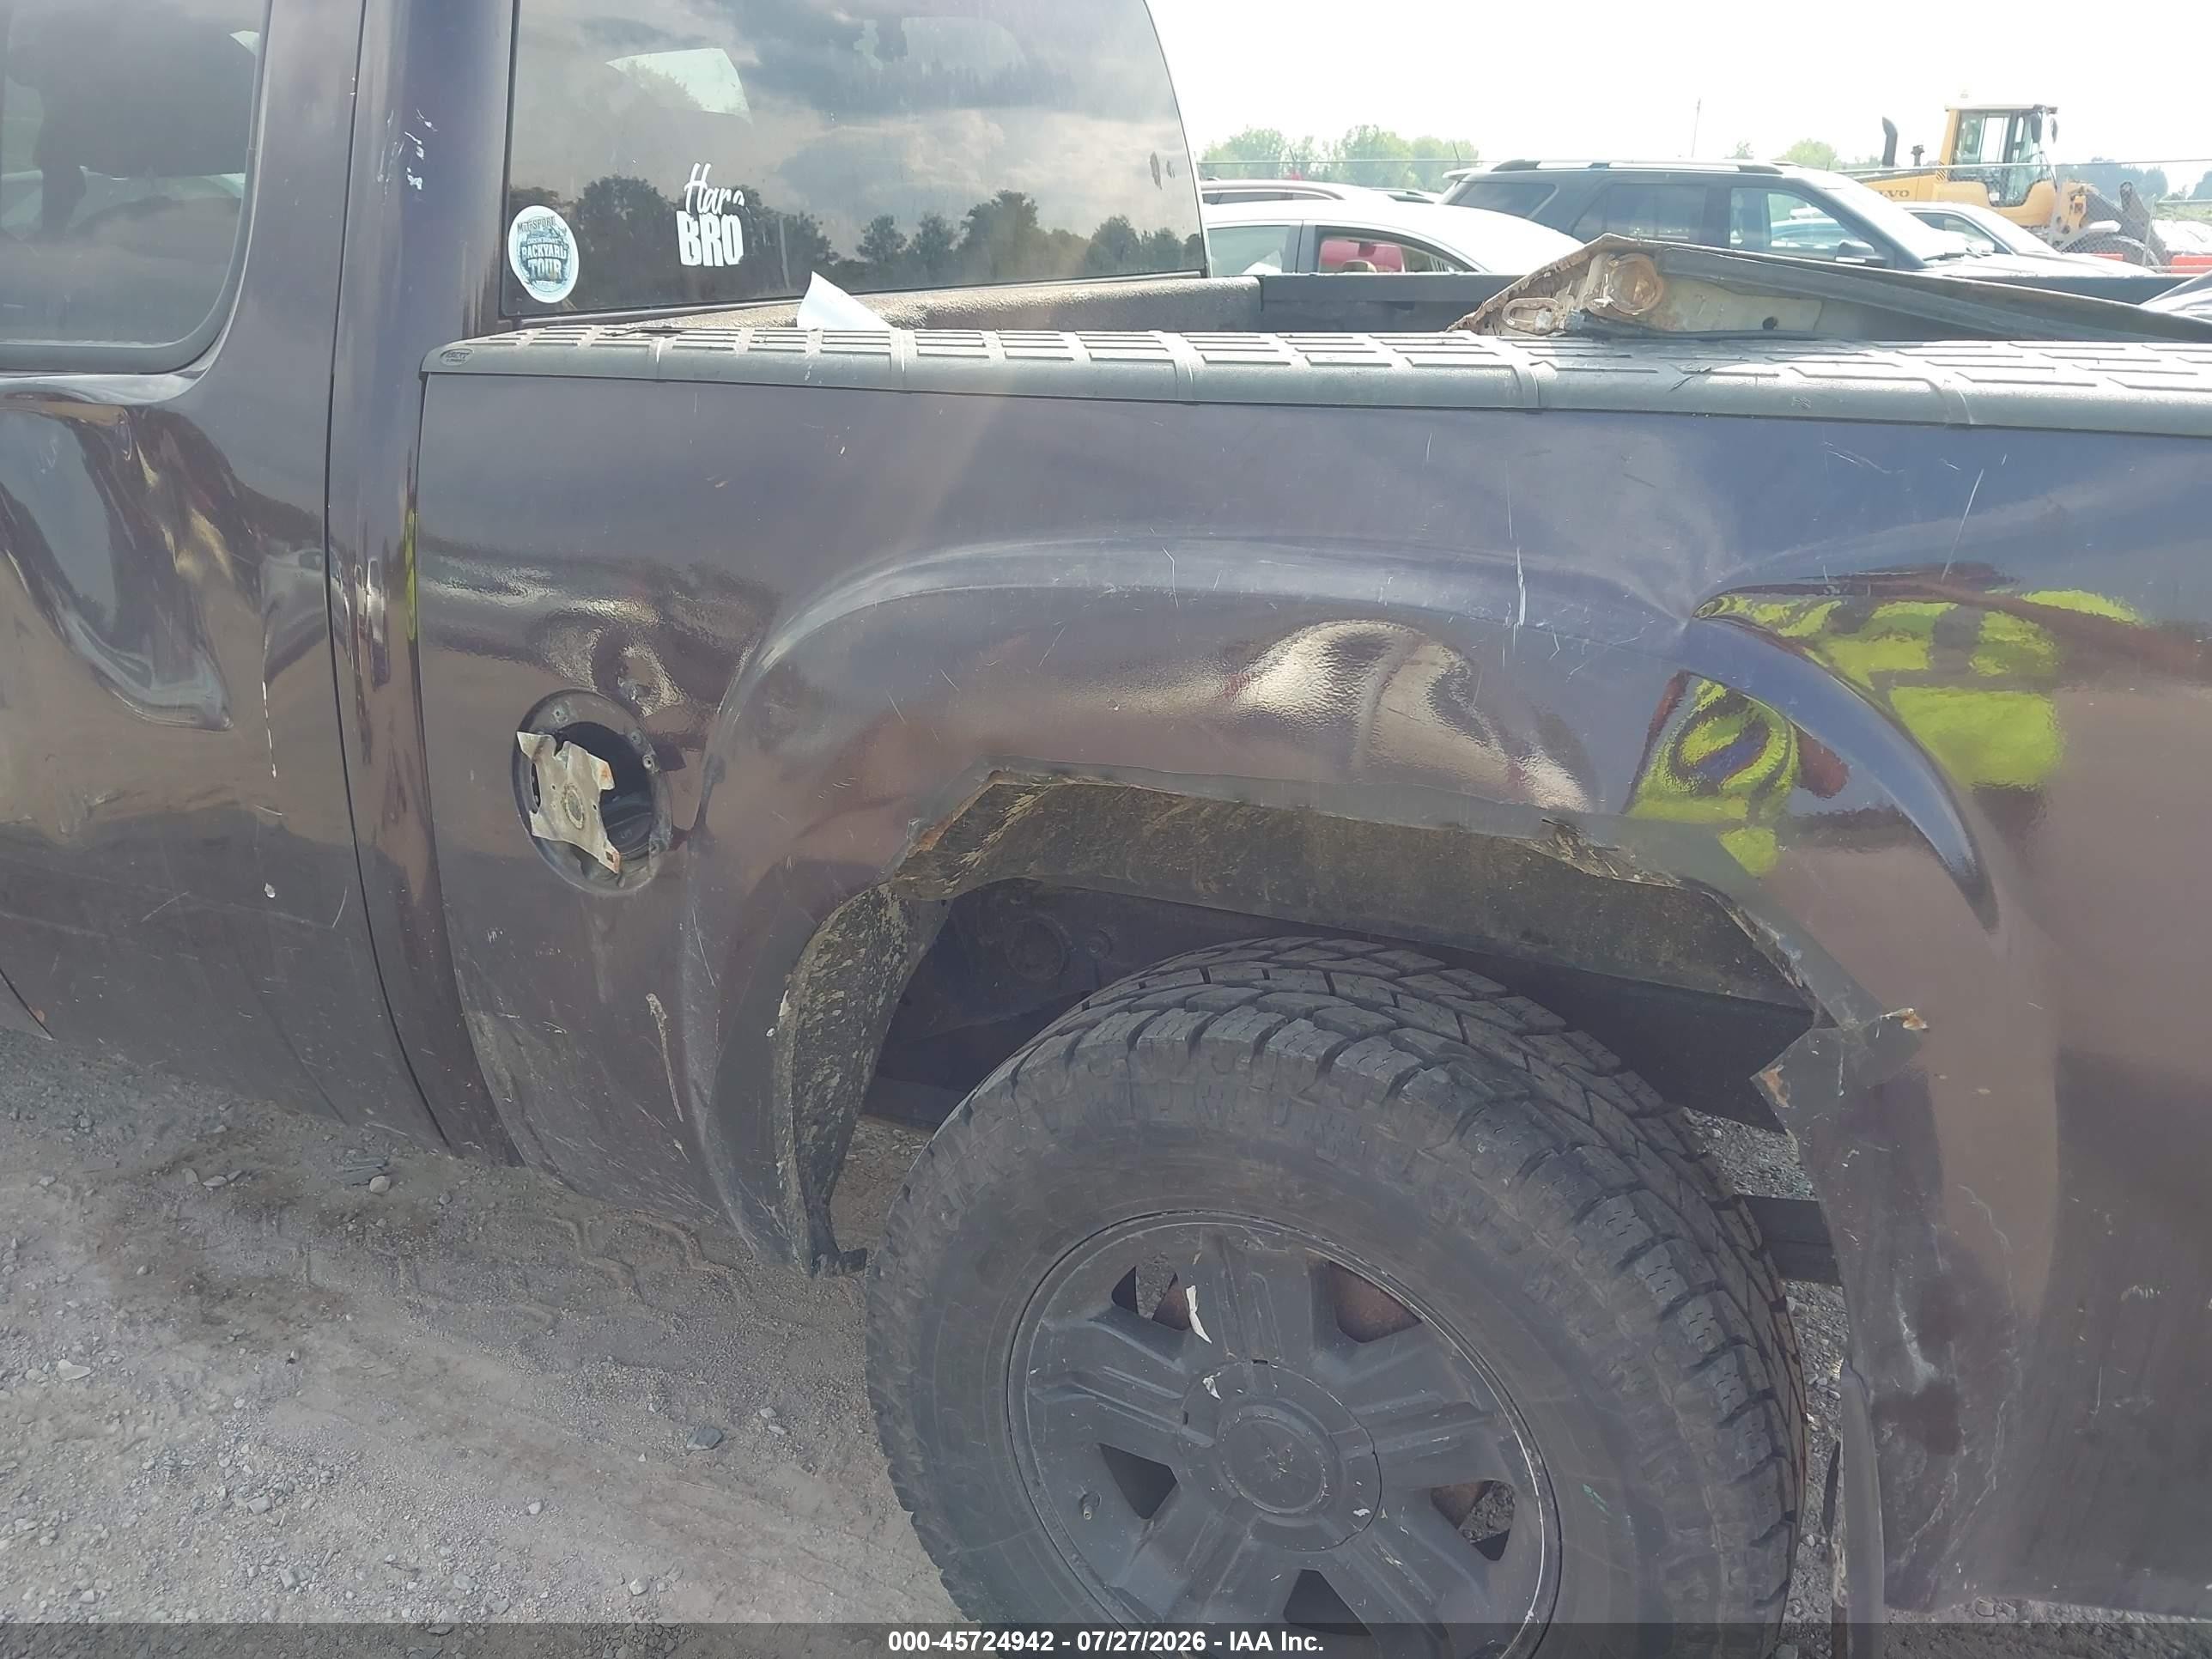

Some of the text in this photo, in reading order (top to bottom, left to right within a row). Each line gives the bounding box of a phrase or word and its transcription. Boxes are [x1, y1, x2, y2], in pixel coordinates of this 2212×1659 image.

[676, 210, 744, 267] BRO
[521, 243, 567, 261] BACKYARD
[527, 258, 562, 280] TOUR
